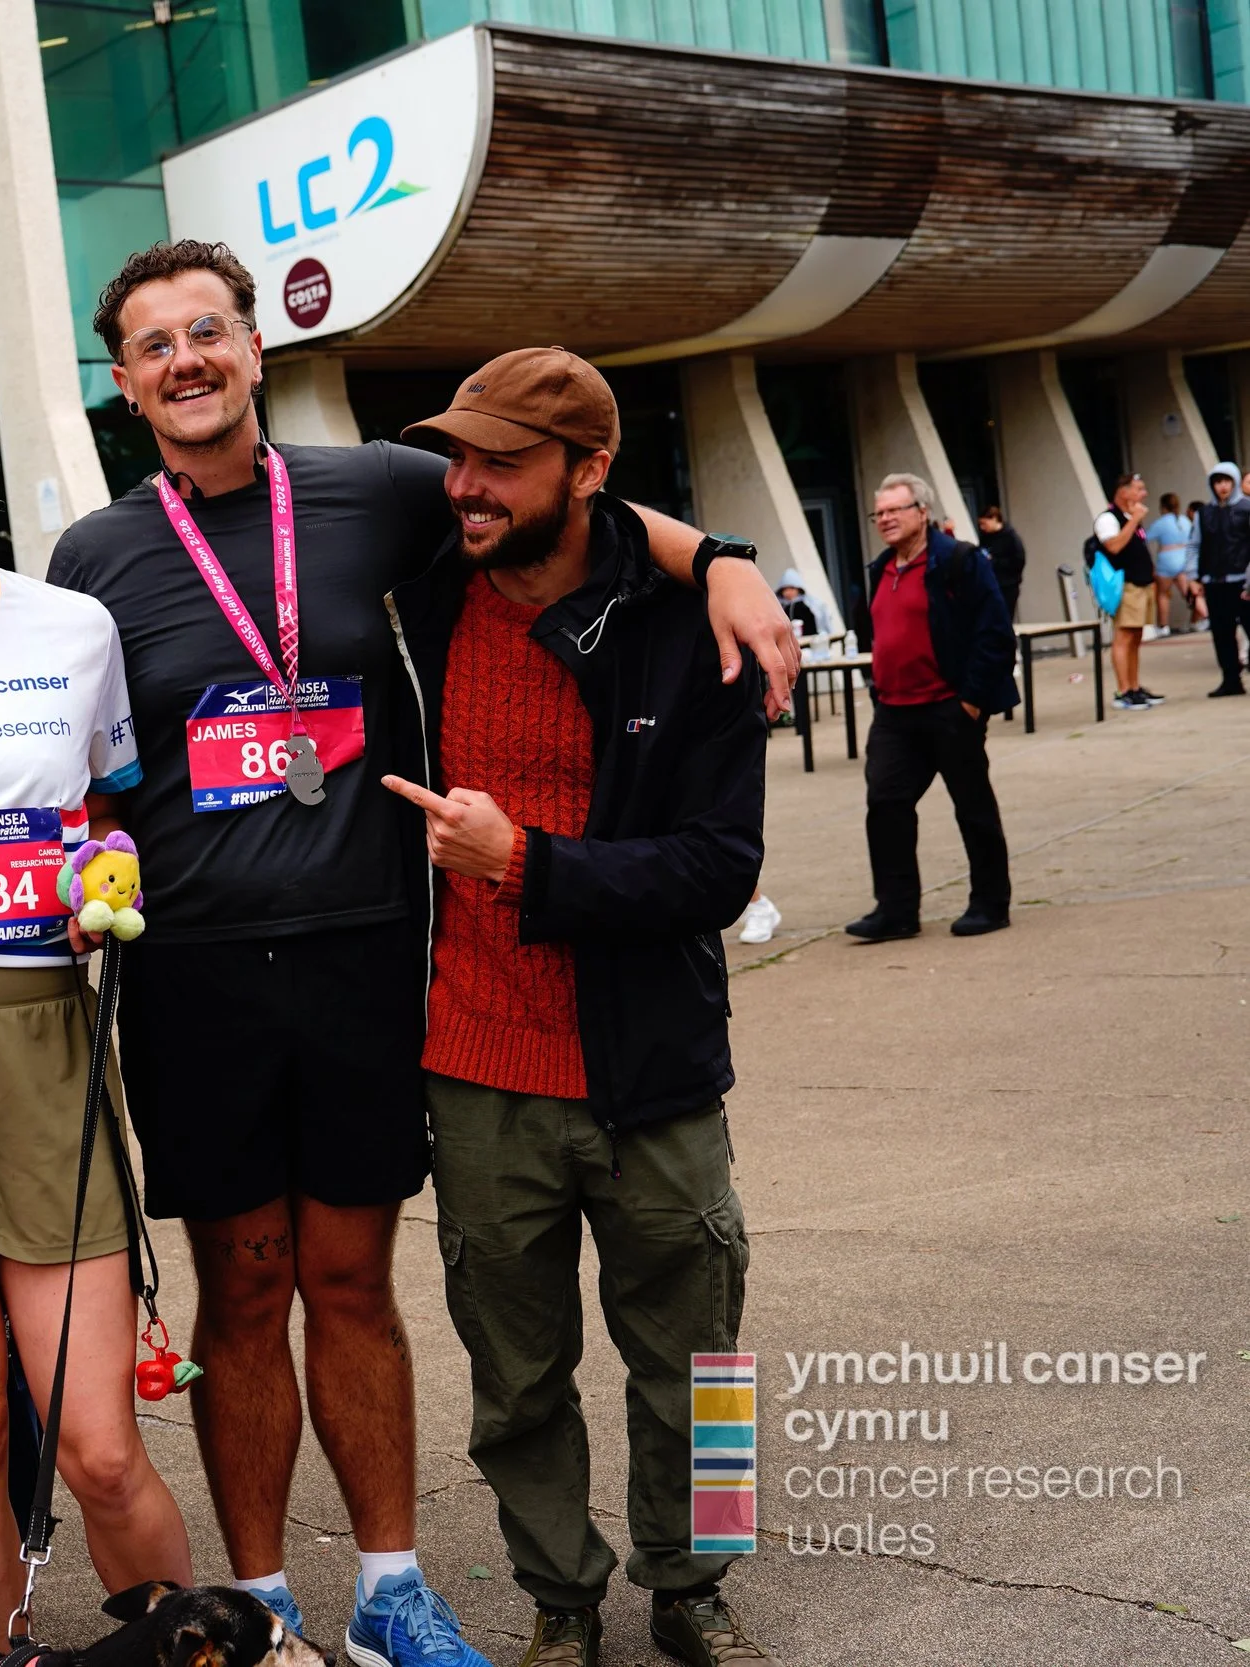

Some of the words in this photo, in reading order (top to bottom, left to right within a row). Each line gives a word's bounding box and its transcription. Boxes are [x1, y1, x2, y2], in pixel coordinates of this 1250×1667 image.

[257, 116, 394, 244] LC2
[288, 283, 328, 309] COSTA
[276, 486, 286, 514] 2026
[179, 519, 200, 547] 2026
[196, 546, 232, 602] Marathon
[283, 538, 293, 591] FRONTRUNNER
[226, 595, 246, 619] Half
[236, 616, 273, 672] SWANSEA
[291, 692, 330, 704] arathon
[110, 713, 135, 747] #T
[192, 722, 257, 742] JAMES
[241, 739, 318, 779] 86
[10, 859, 44, 868] RESEARCH
[44, 858, 64, 866] WALES
[38, 848, 62, 857] CANCER
[393, 1579, 419, 1595] HOKA
[263, 1598, 284, 1607] OKA
